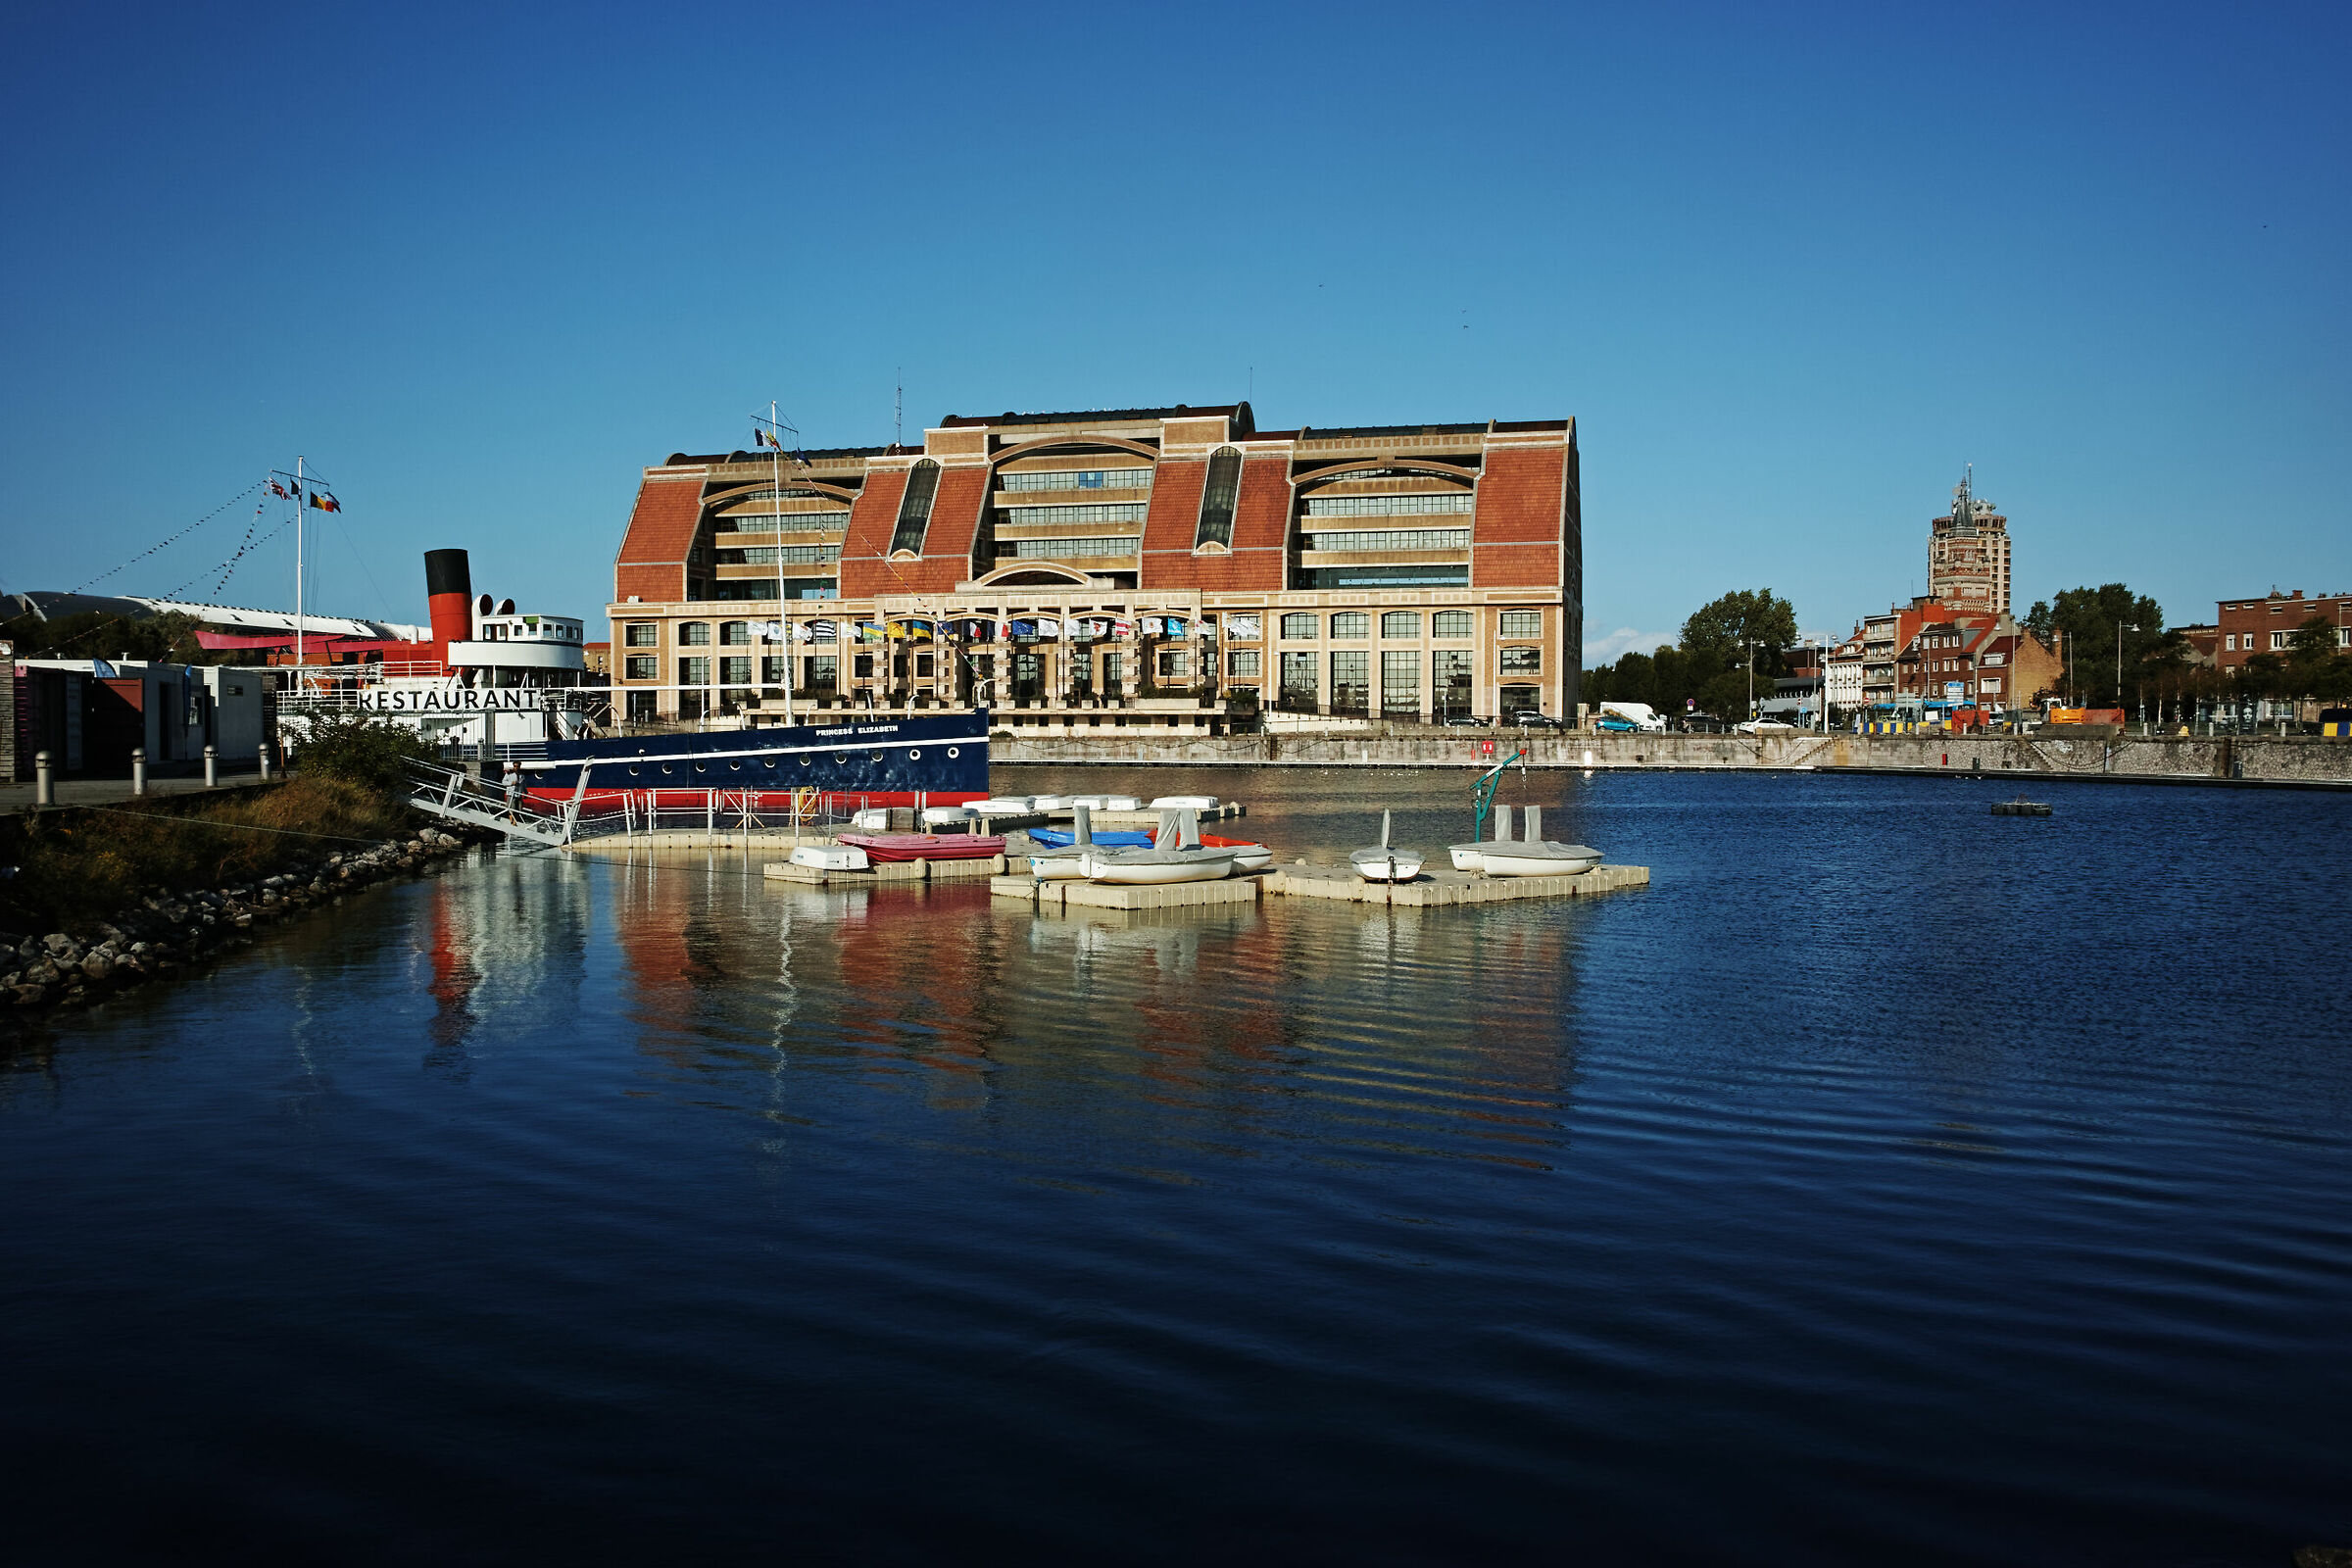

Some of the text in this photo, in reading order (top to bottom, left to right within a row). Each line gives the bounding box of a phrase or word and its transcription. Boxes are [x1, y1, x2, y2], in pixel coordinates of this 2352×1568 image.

[359, 690, 537, 710] RESTAURANT
[815, 725, 899, 737] PRINCESS ELIZABETH
